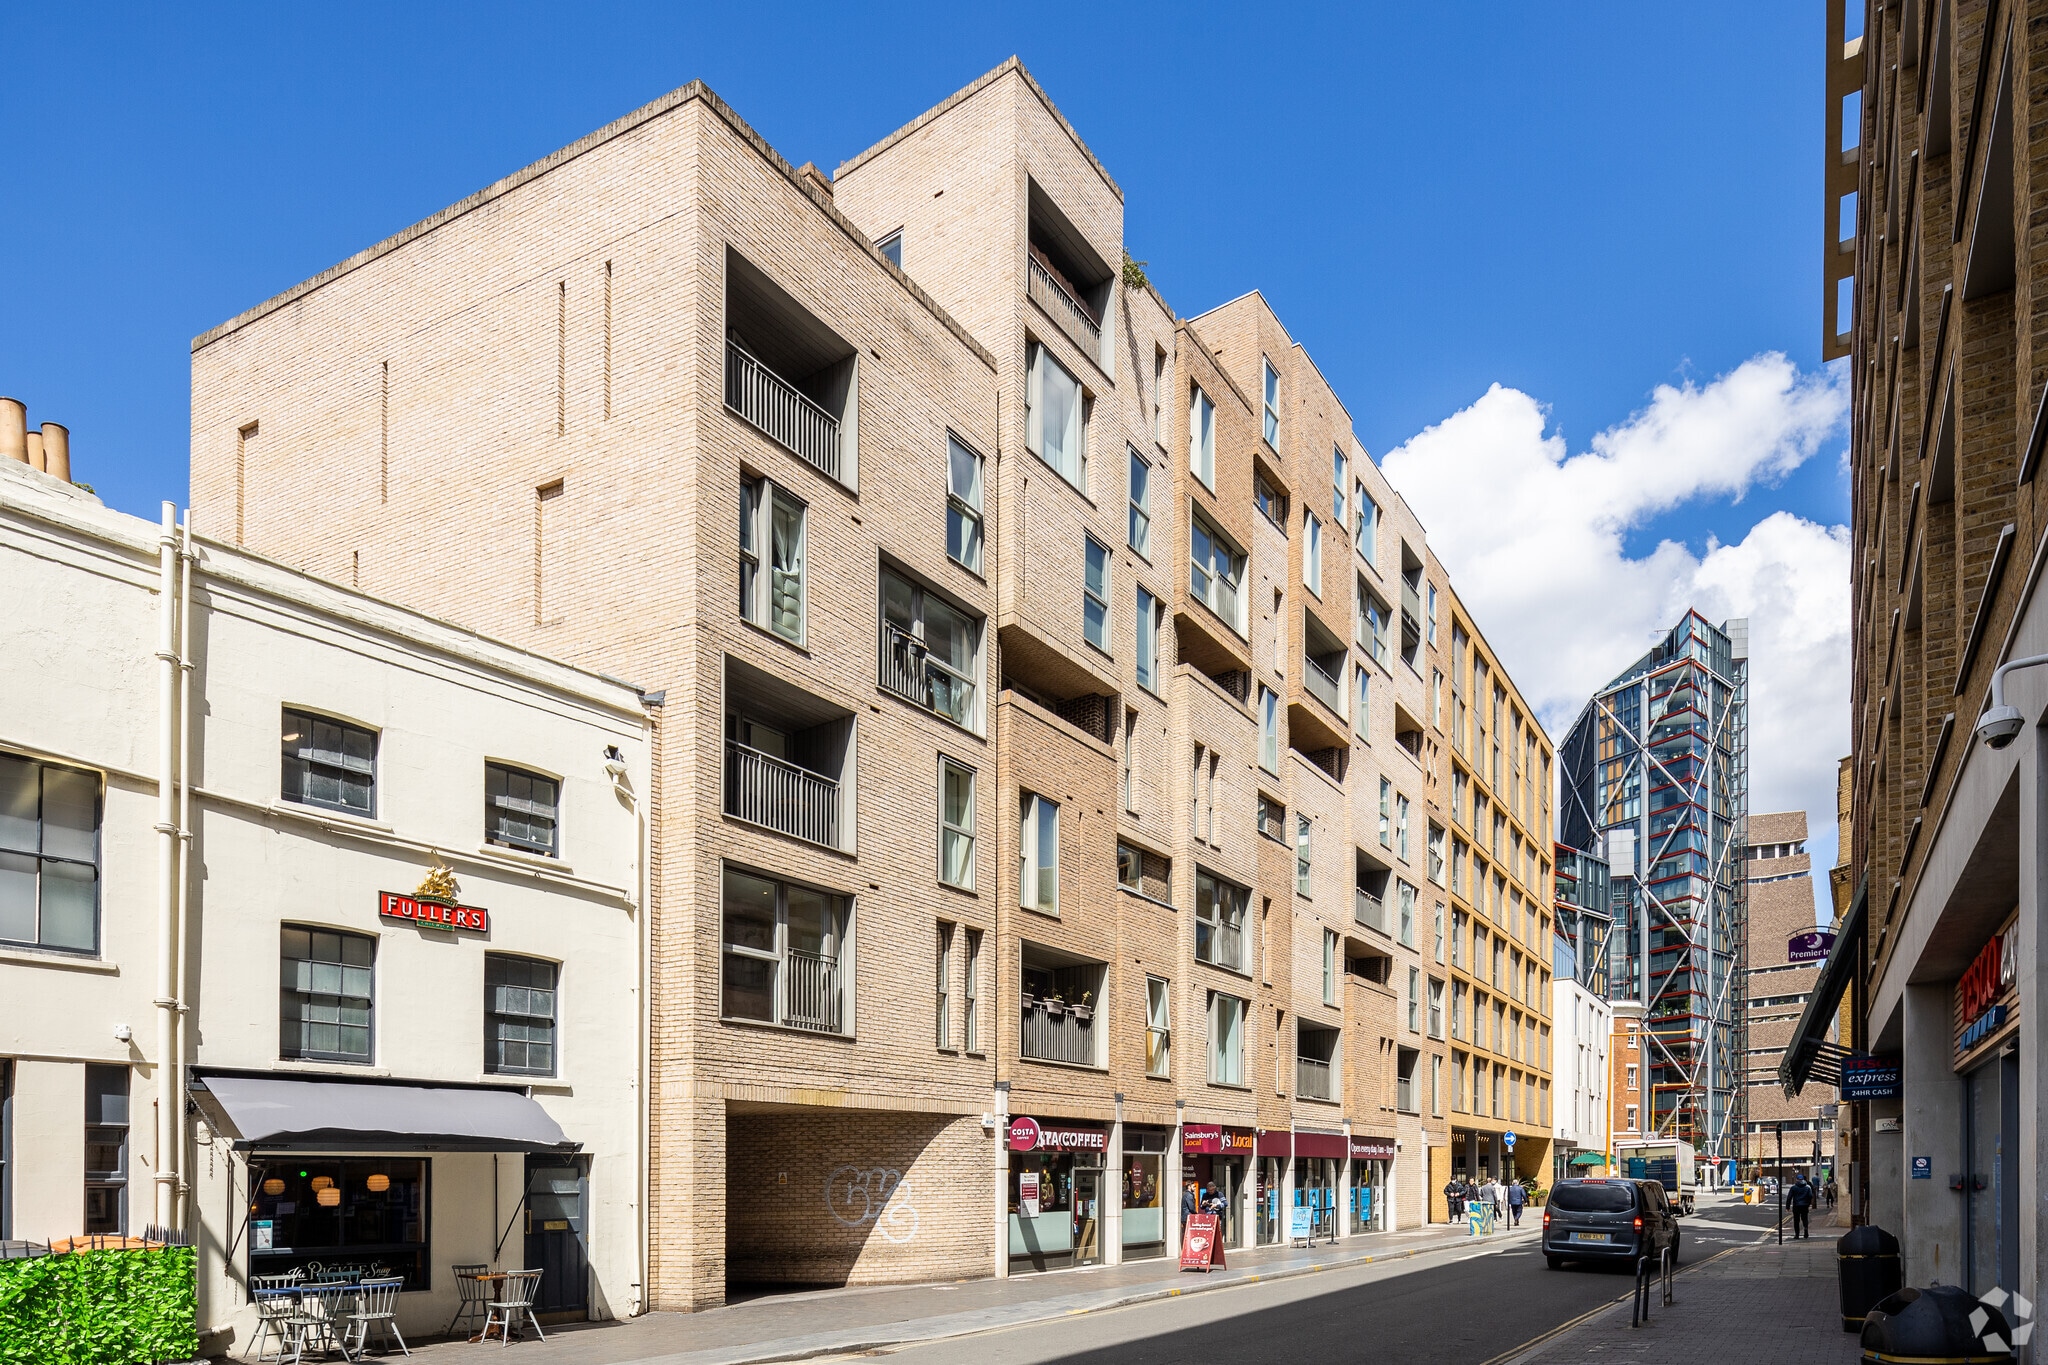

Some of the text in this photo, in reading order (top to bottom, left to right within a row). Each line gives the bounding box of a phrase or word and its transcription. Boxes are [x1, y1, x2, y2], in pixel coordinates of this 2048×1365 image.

[386, 895, 481, 927] FULLER'S
[1790, 948, 1831, 959] Premier In
[1960, 934, 1999, 1024] TESCO
[1846, 1058, 1899, 1070] TESCO
[1848, 1073, 1897, 1085] express
[1851, 1088, 1893, 1097] 24HR CASH
[1012, 1128, 1034, 1136] COSTA
[1184, 1131, 1219, 1140] Sainsbury's
[1059, 1132, 1104, 1148] COFFEE
[1232, 1132, 1253, 1148] Local
[1351, 1142, 1360, 1155] Open
[1360, 1145, 1370, 1155] every
[288, 1266, 308, 1281] The
[364, 1262, 392, 1279] Snug
